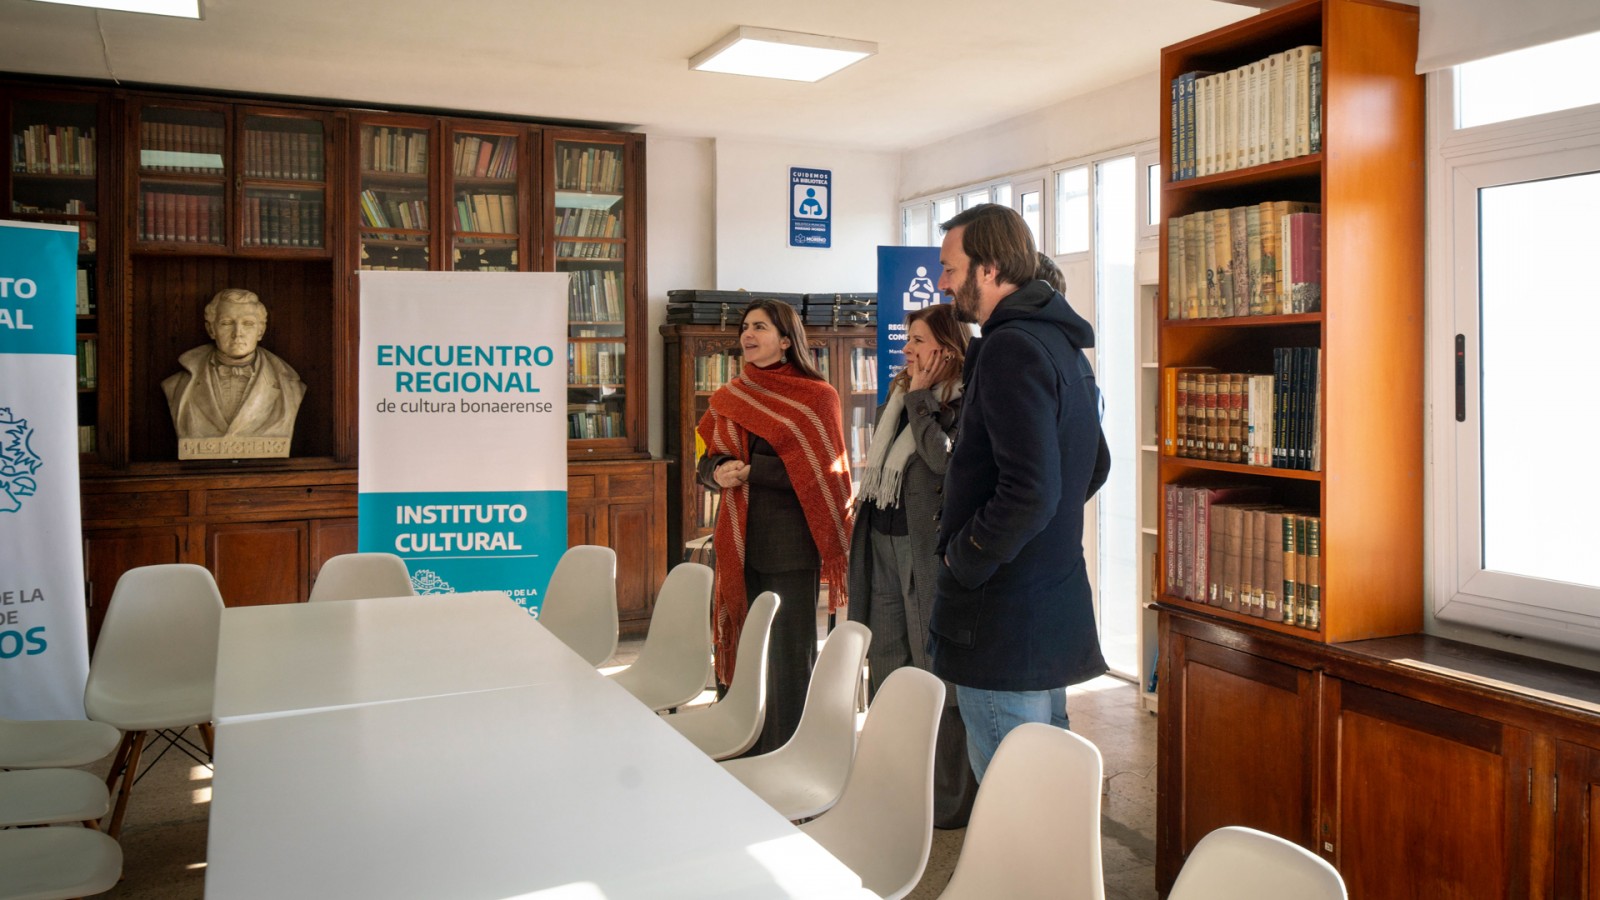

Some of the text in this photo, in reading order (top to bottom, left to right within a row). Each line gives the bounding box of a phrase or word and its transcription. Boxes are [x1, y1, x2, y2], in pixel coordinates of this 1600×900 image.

[1180, 84, 1184, 95] 3
[1187, 82, 1193, 93] 4
[377, 345, 554, 367] ENCUENTRO
[395, 371, 541, 393] REGIONAL
[376, 398, 553, 413] de cultura bonaerense
[396, 504, 528, 524] INSTITUTO
[395, 532, 522, 552] CULTURAL
[20, 588, 45, 603] LA
